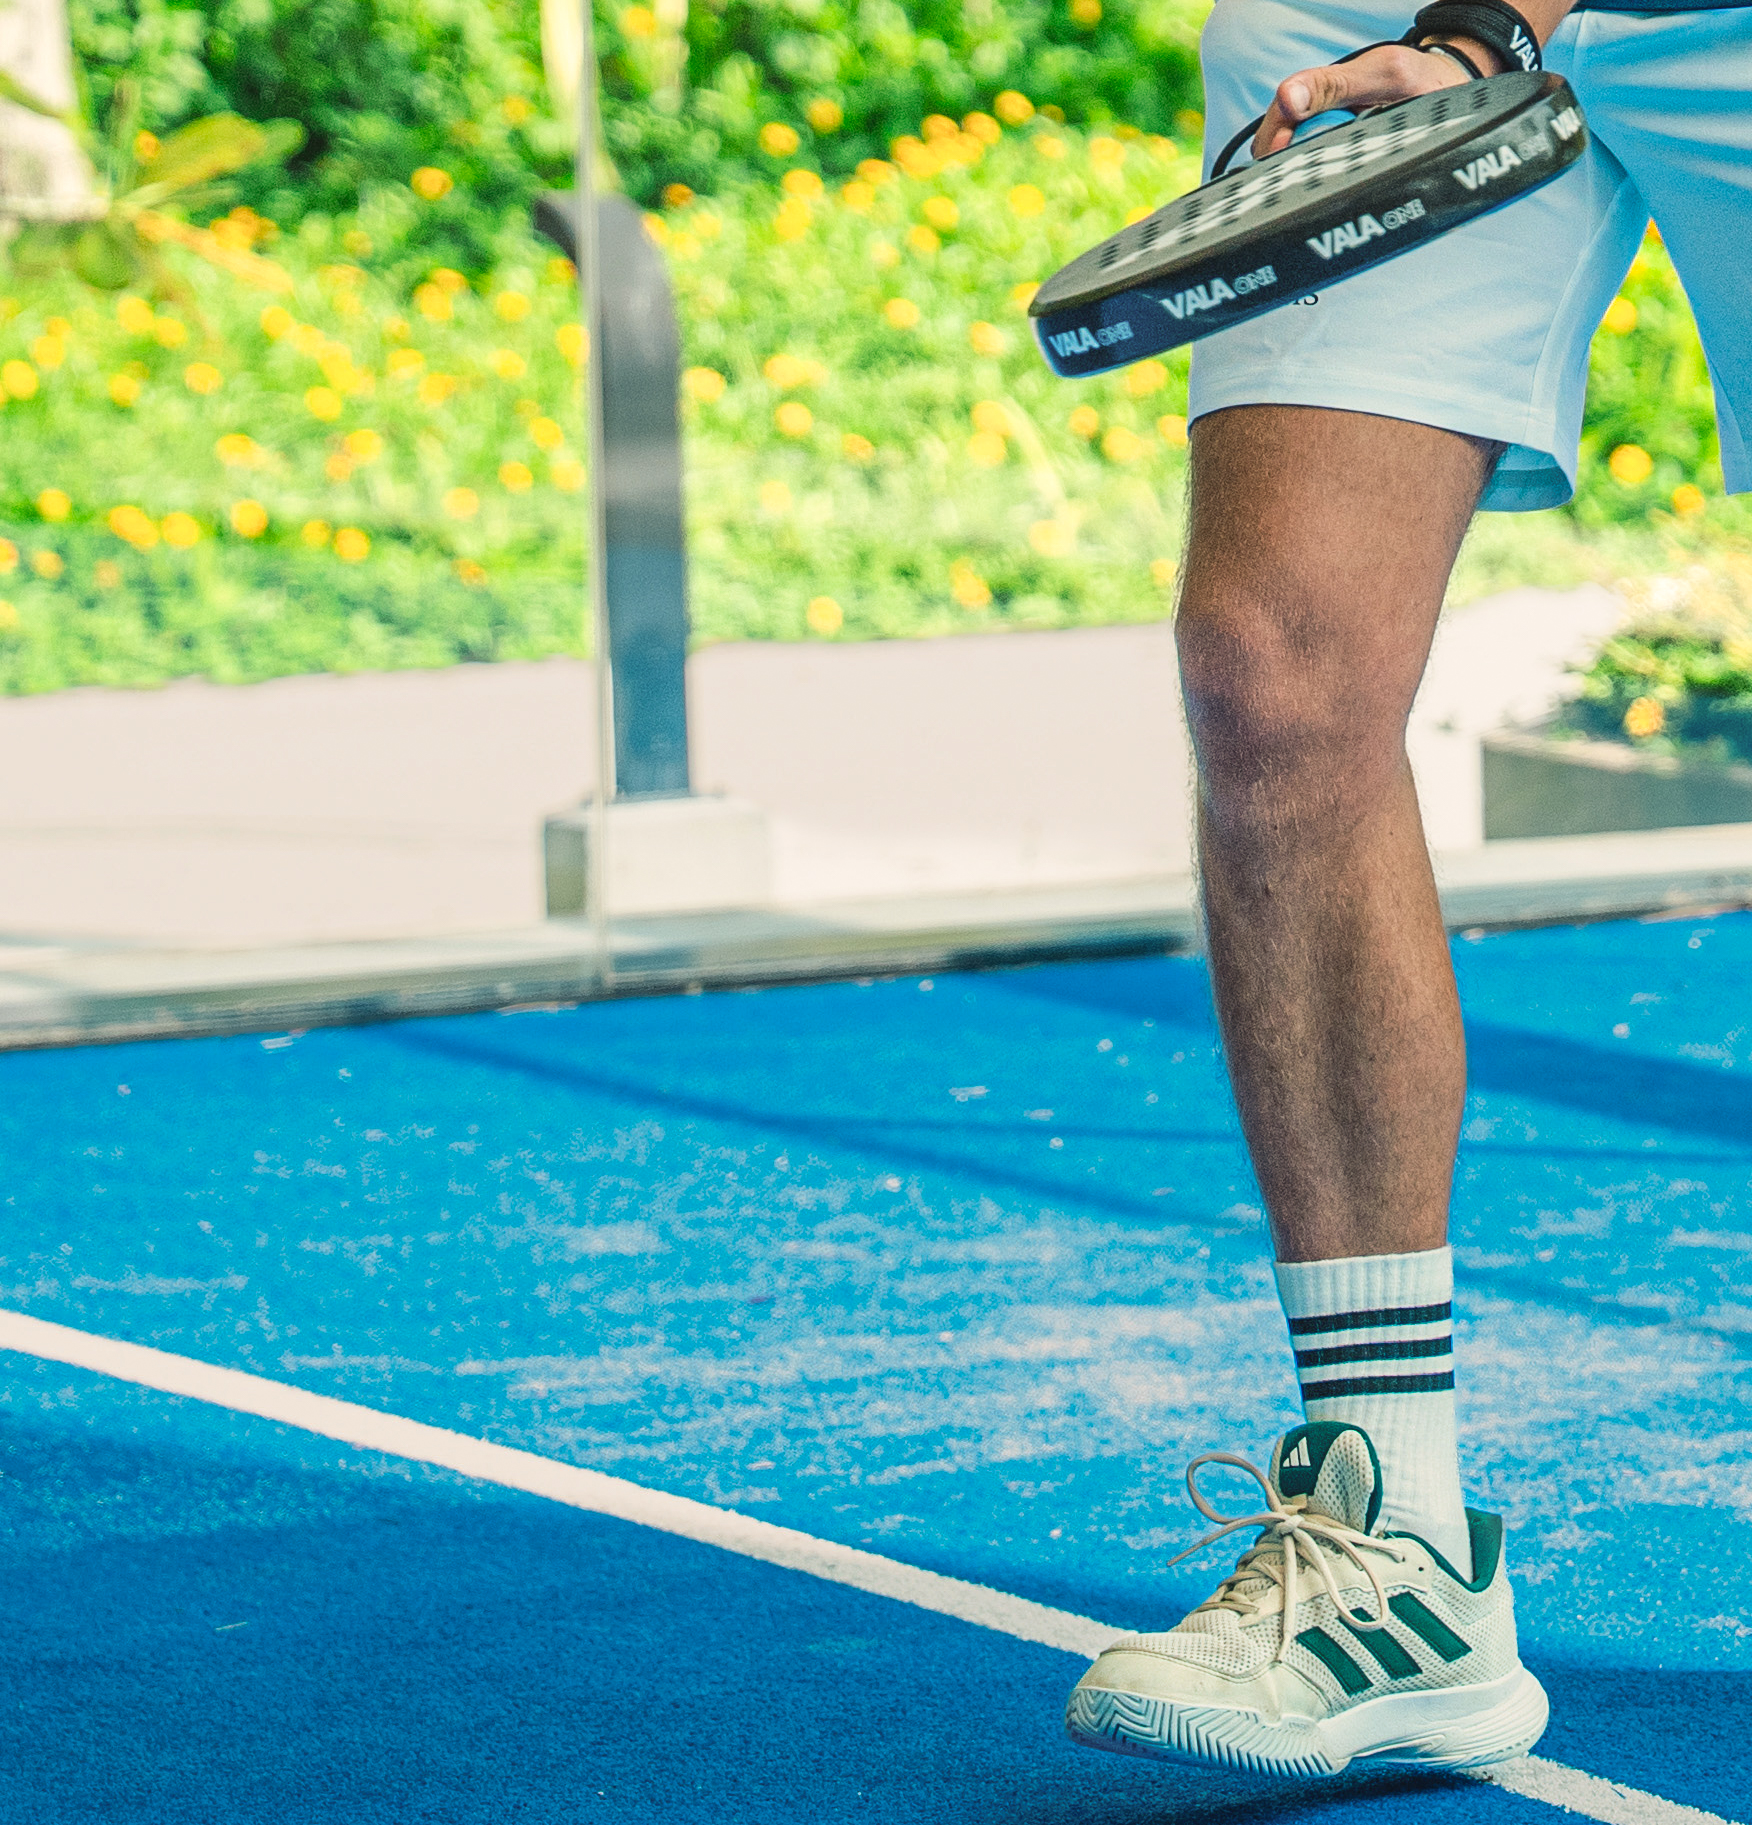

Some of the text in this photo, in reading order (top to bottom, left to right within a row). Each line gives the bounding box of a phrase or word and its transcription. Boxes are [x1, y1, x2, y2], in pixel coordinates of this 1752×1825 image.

[1452, 145, 1522, 190] VALA
[1306, 198, 1426, 260] VALA ONE
[1159, 265, 1278, 320] VALA ONE
[1048, 327, 1100, 357] VALA
